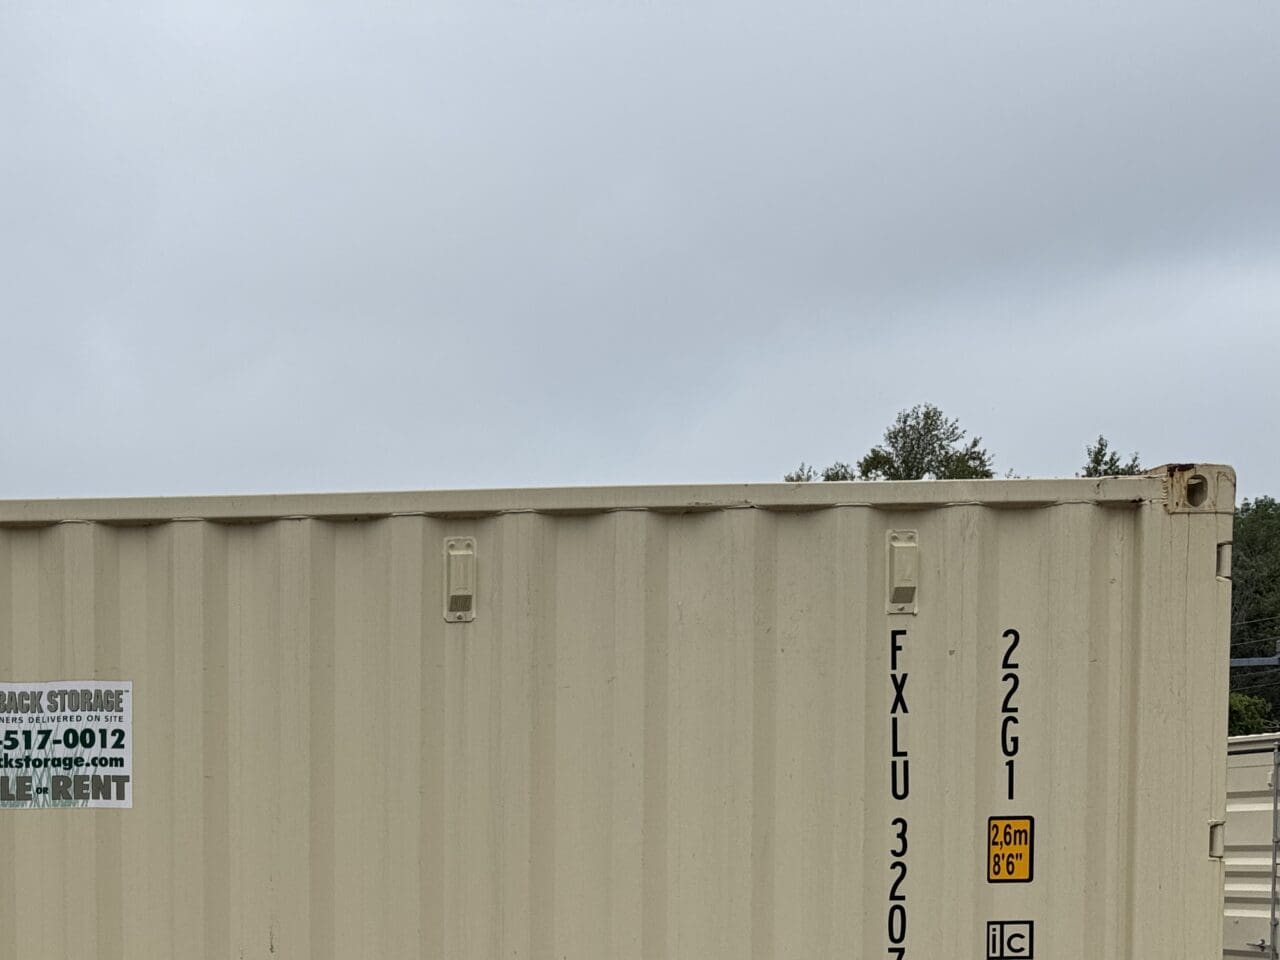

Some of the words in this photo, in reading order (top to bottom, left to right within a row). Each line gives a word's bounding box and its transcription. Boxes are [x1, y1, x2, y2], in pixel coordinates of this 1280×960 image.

[47, 689, 124, 713] STORAGE
[28, 714, 83, 723] DELIVERED
[86, 714, 101, 722] ON
[105, 714, 124, 722] SITE
[890, 629, 910, 800] FXLU
[1001, 628, 1020, 800] 22G1
[36, 787, 49, 795] OR
[52, 775, 130, 800] RENT
[991, 823, 1028, 850] 2,6m
[992, 852, 1023, 876] 8'6"
